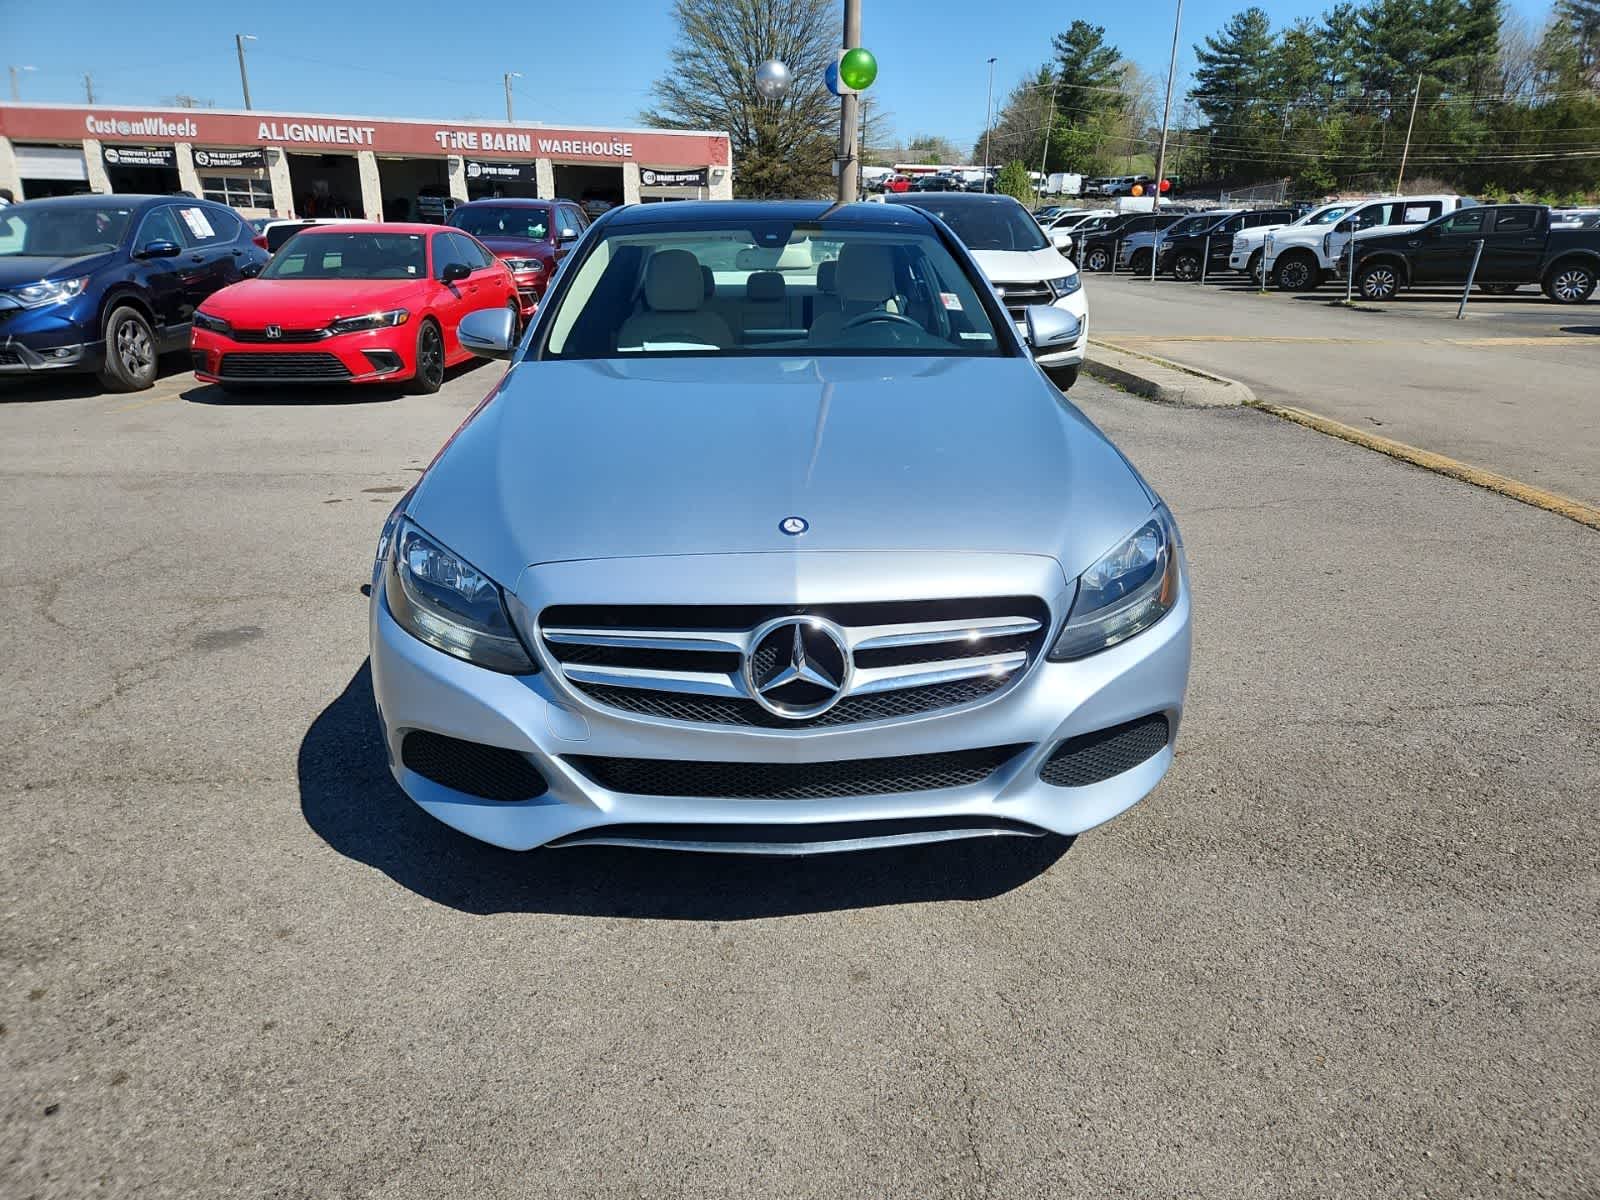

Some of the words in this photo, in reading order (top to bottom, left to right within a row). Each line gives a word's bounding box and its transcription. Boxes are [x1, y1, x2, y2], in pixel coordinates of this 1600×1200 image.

[257, 122, 376, 145] ALIGNMENT
[481, 133, 532, 152] BARN
[538, 139, 633, 157] WAREHOUSE
